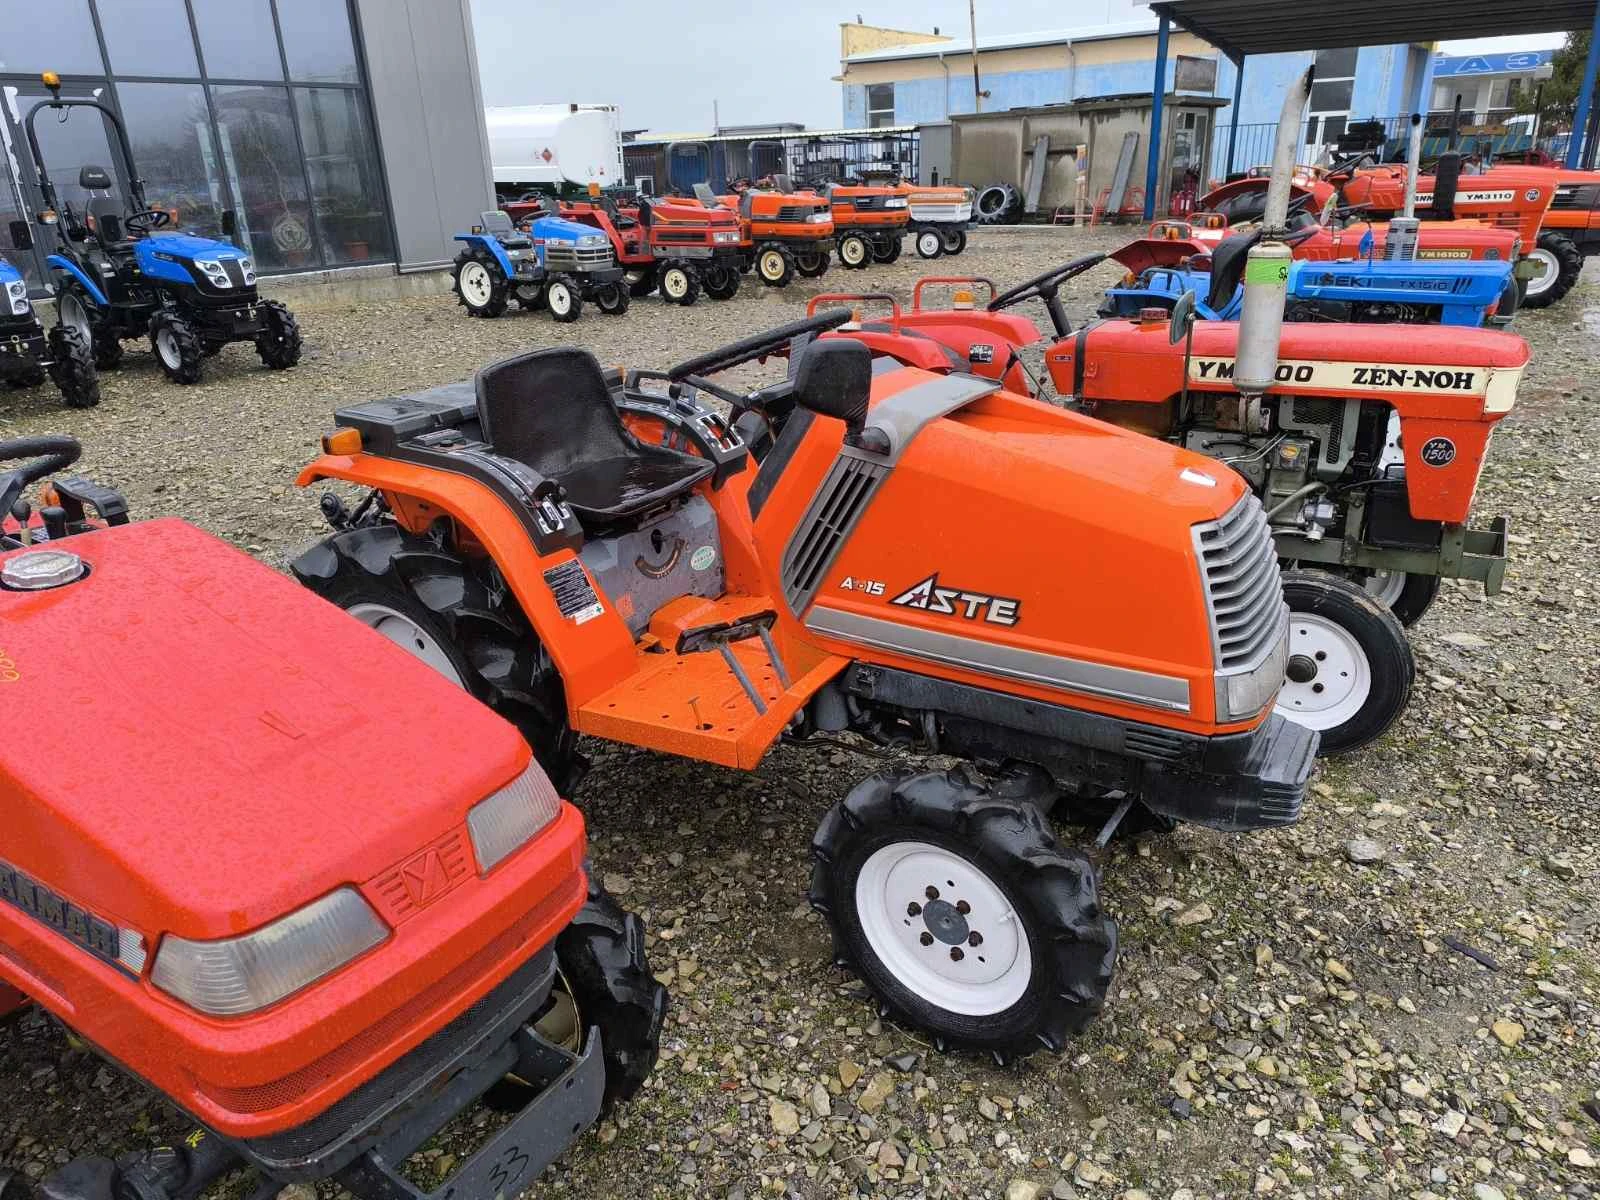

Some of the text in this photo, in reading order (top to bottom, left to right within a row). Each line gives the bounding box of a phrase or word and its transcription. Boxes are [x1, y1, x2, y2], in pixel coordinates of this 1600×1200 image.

[1466, 193, 1512, 201] YM3110
[1198, 361, 1475, 390] YM00 ZEN-NOH
[1424, 449, 1454, 461] 1500
[888, 573, 1021, 627] ASTE
[0, 862, 119, 960] ANMAR
[487, 1146, 529, 1192] 33
